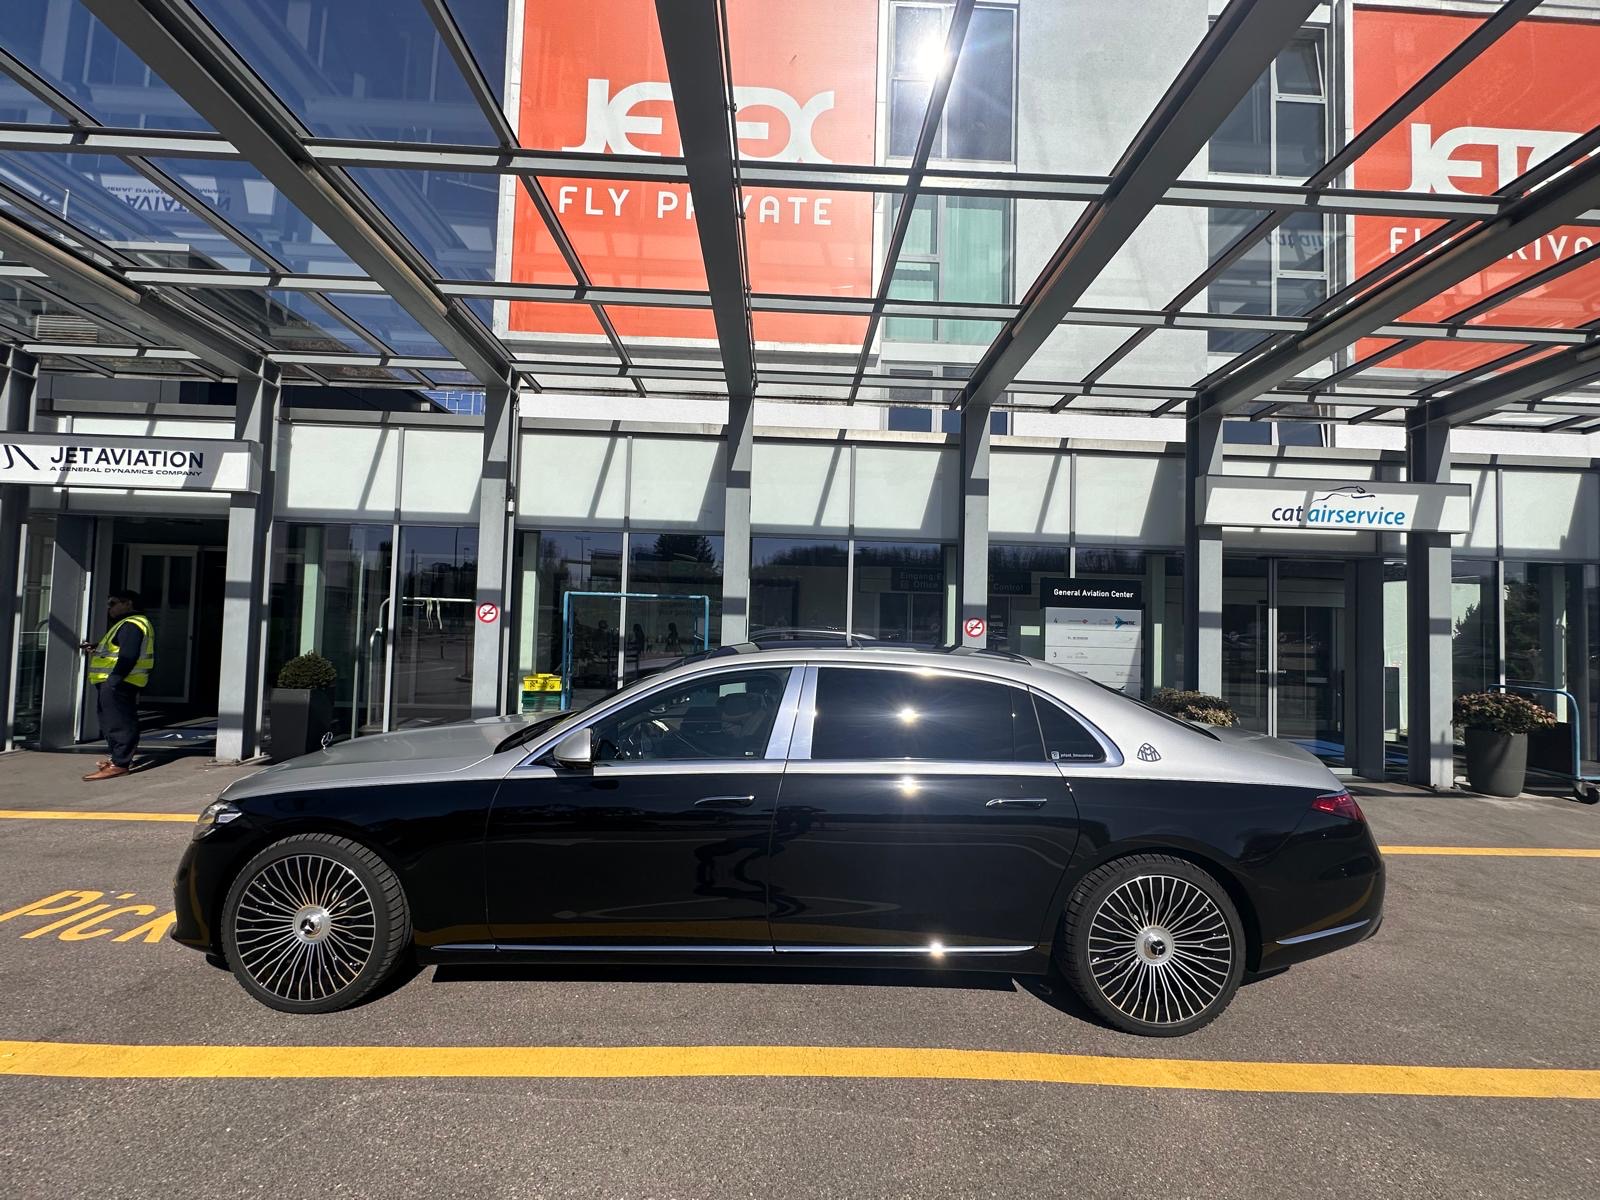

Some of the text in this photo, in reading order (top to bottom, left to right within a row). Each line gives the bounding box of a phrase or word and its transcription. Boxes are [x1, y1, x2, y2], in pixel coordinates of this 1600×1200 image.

[559, 186, 630, 217] FLY
[50, 446, 204, 469] JET AVIATION
[155, 469, 203, 477] COMPANY
[1271, 504, 1406, 526] cat airservice
[1053, 588, 1134, 598] General Aviation Center
